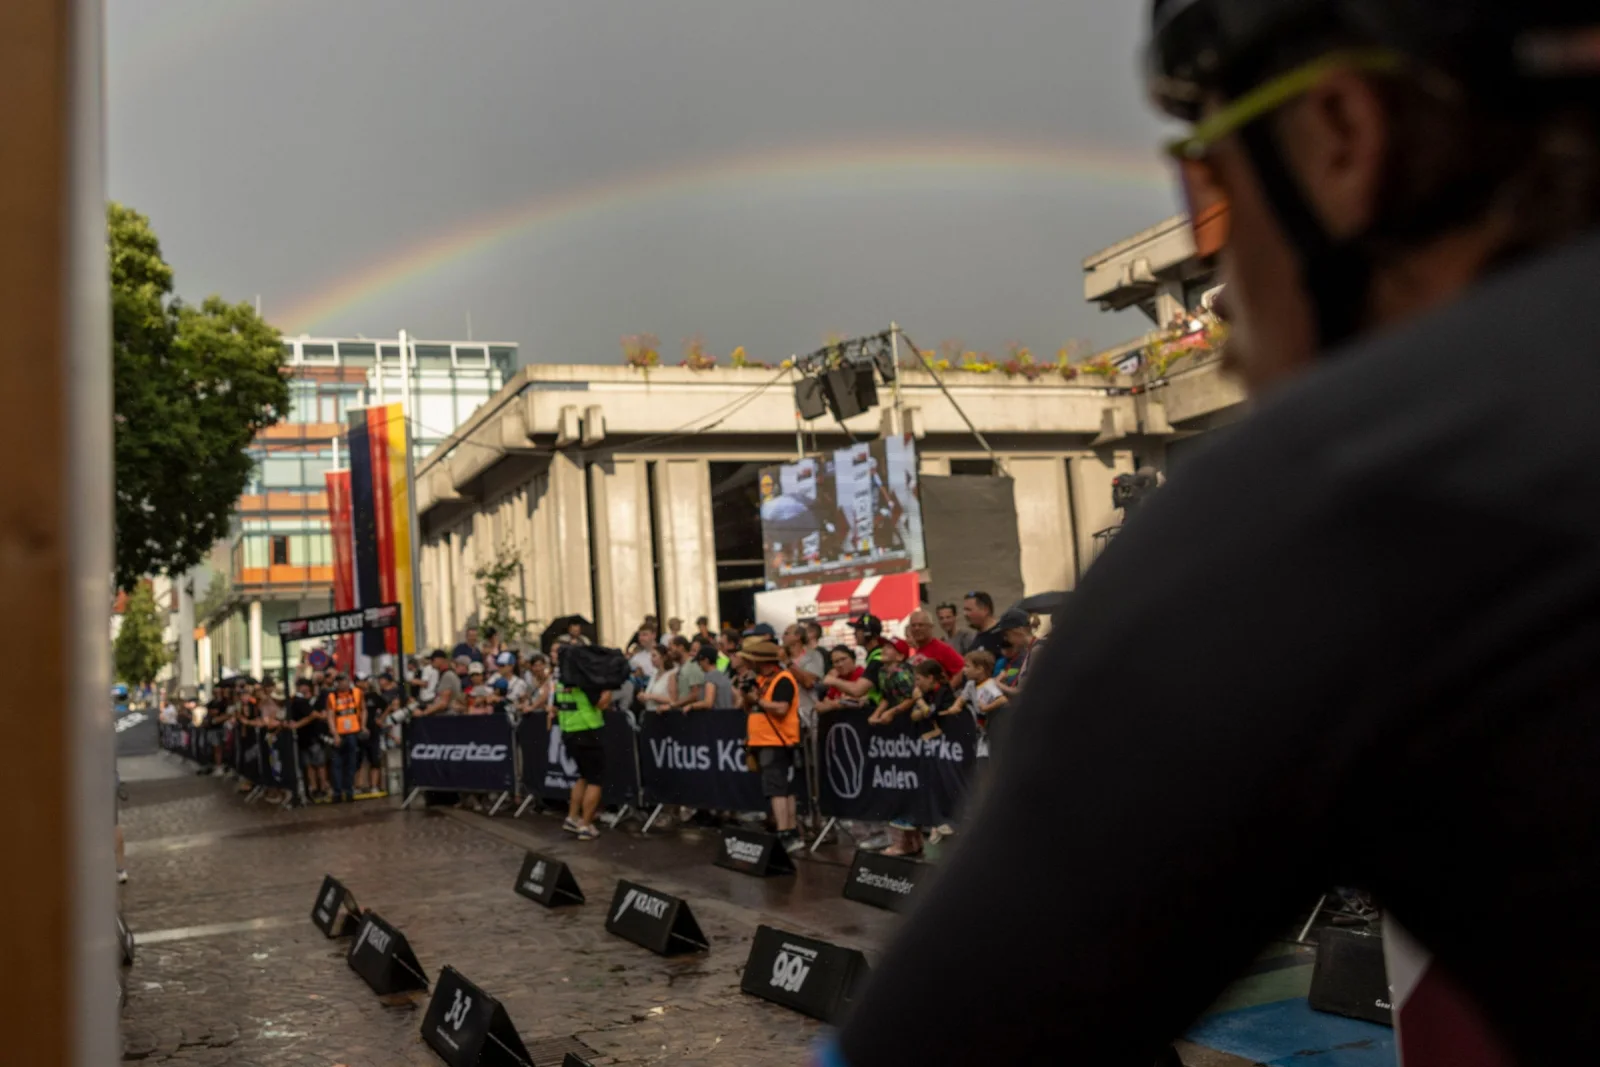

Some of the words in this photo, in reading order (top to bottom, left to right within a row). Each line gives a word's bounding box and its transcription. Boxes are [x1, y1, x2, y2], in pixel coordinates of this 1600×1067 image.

[308, 617, 339, 635] RIDER
[340, 613, 364, 630] EXIT
[411, 741, 508, 762] corratec
[649, 735, 711, 770] Vitus
[872, 764, 919, 790] Aalen
